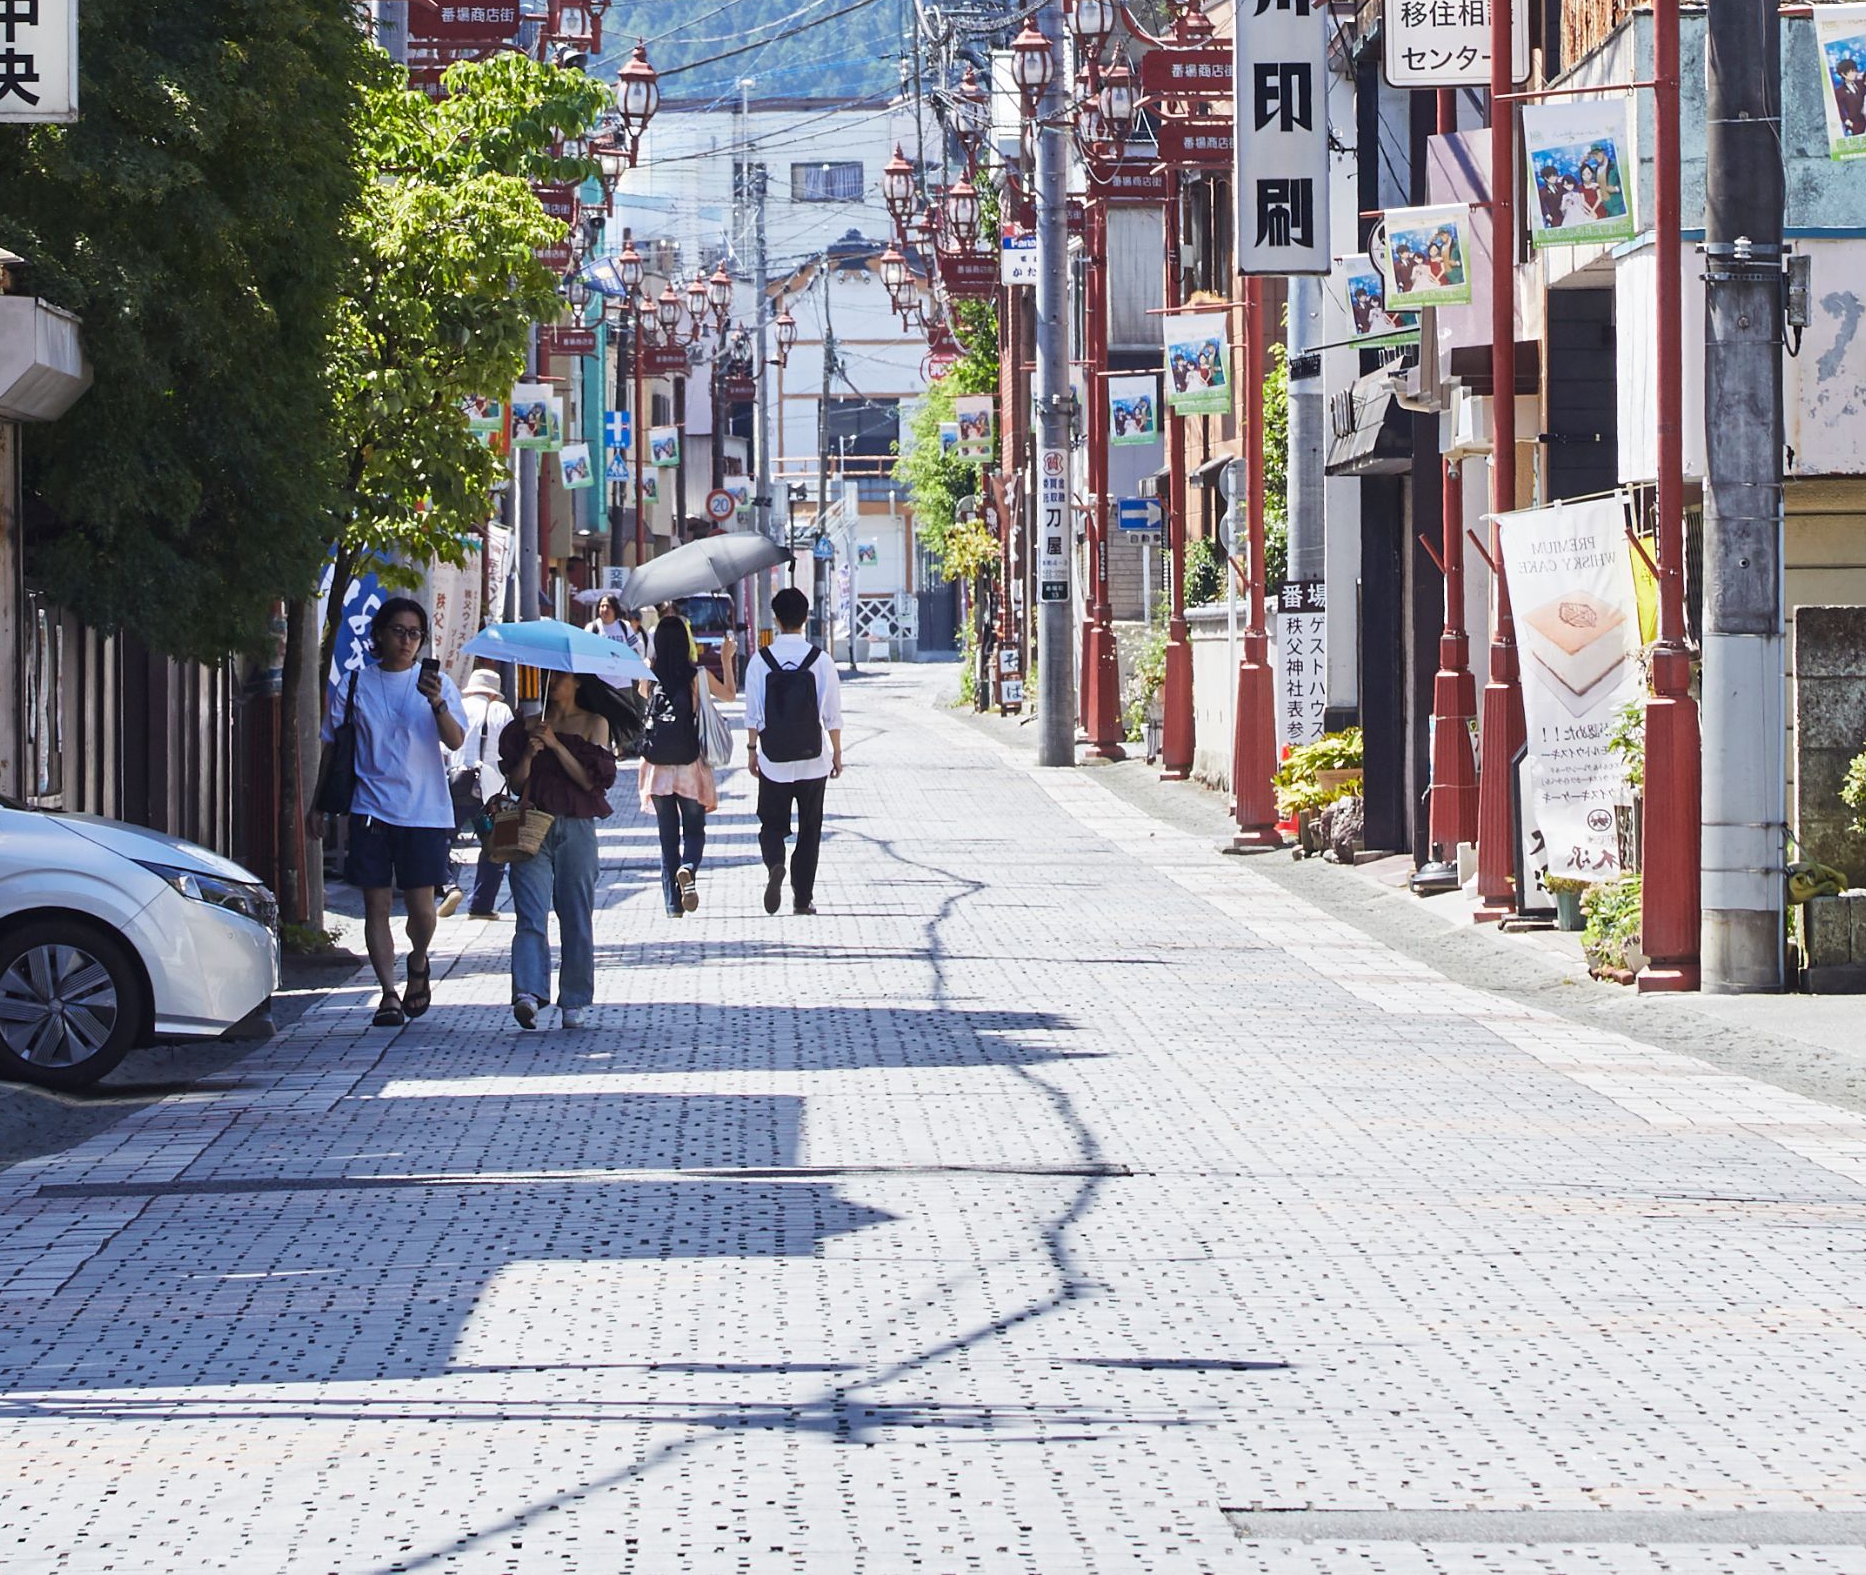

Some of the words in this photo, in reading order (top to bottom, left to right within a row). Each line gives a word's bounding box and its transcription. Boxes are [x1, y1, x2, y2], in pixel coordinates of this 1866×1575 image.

[441, 7, 515, 23] 番場商店街
[1401, 0, 1513, 28] 移住相
[712, 497, 729, 512] 20
[1046, 508, 1062, 555] 刀屋
[1282, 583, 1325, 609] 番場
[1286, 618, 1304, 747] 秩父神社表参
[1310, 616, 1325, 738] ゲストハウス
